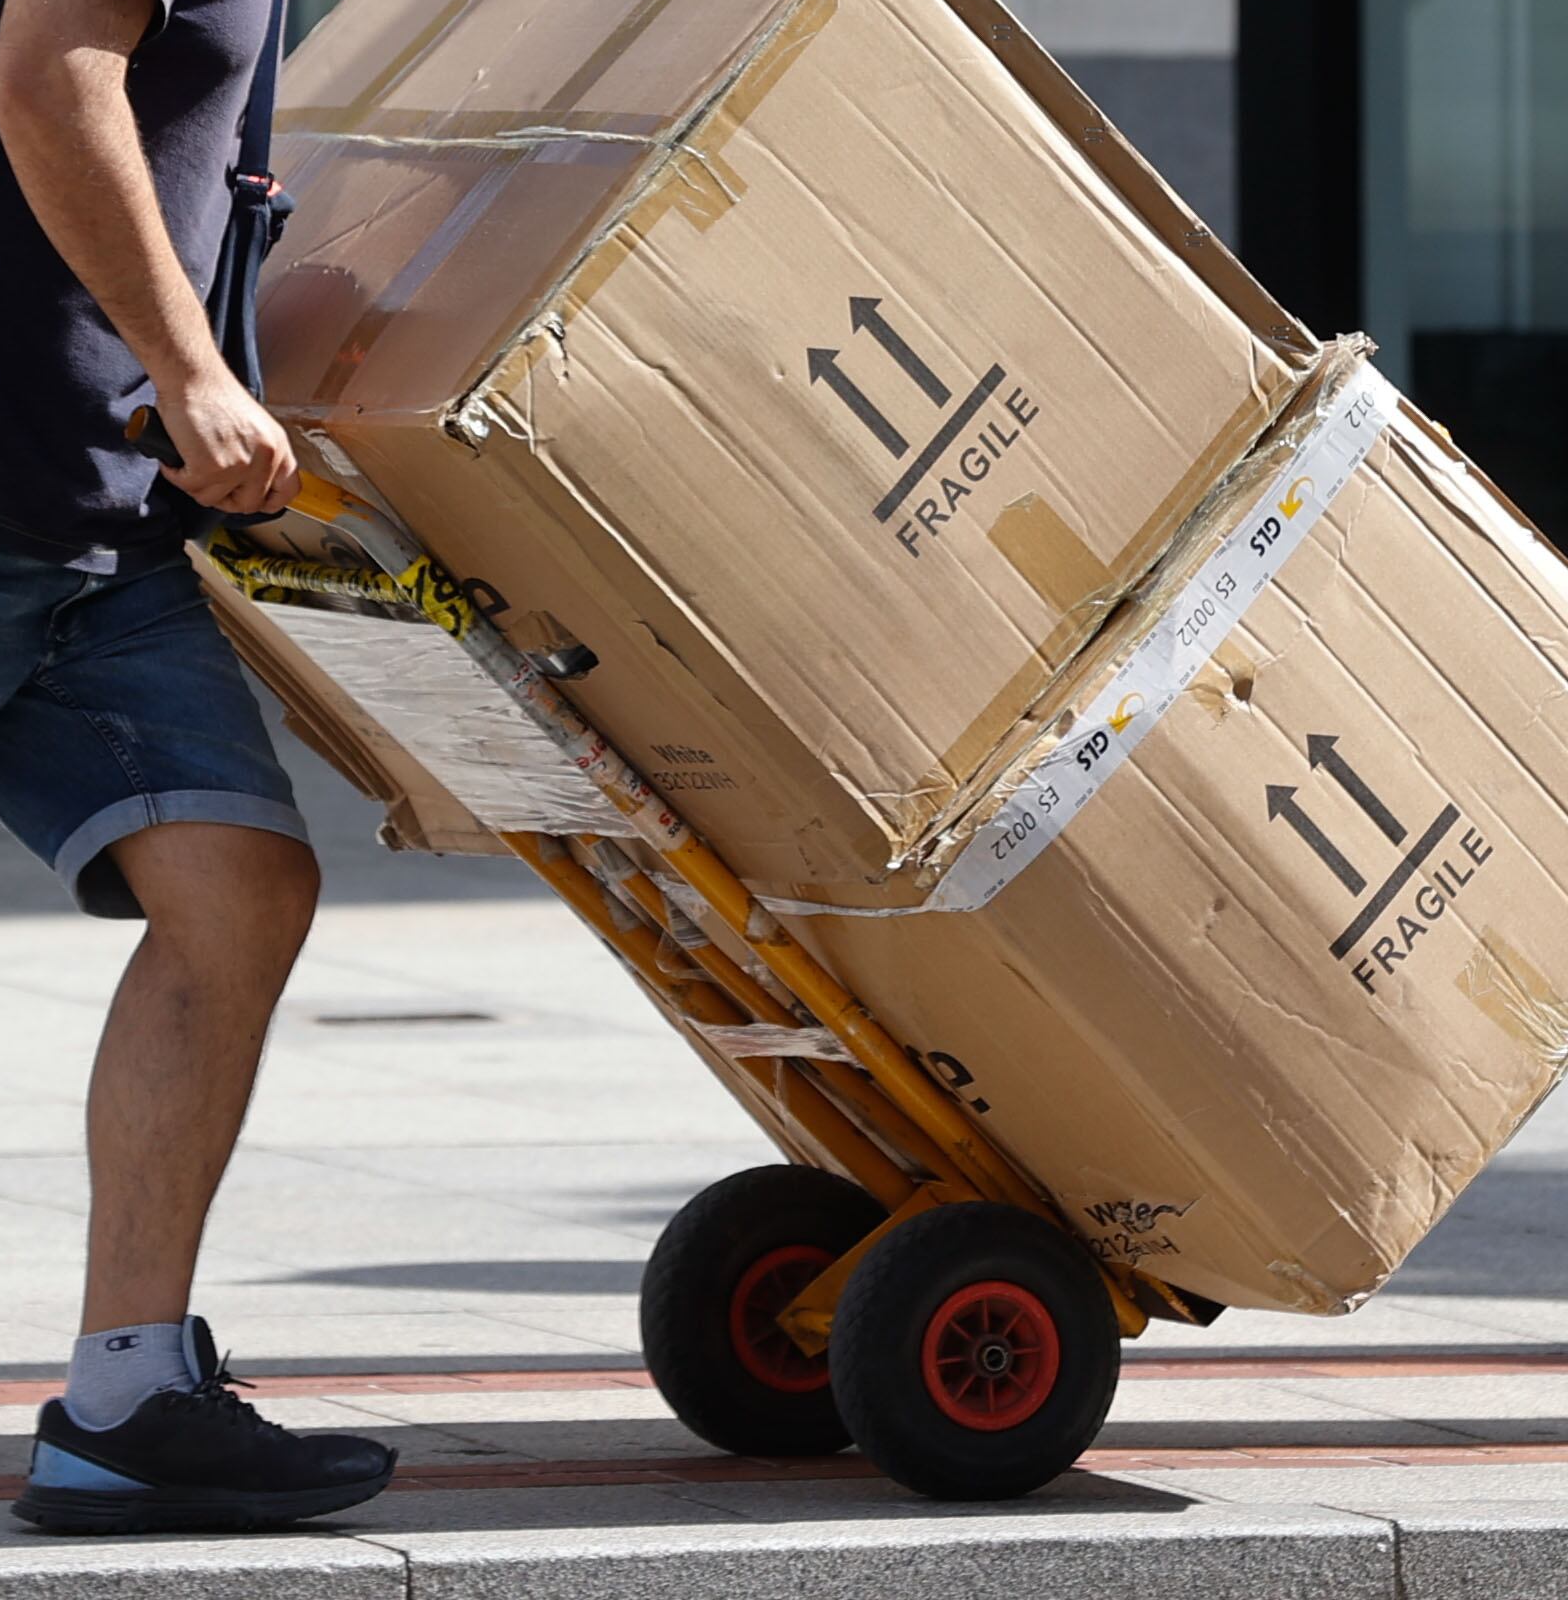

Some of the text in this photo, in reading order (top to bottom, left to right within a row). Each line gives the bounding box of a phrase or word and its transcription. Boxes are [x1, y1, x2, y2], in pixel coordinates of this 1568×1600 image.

[895, 387, 1040, 560] FRAGILE
[1250, 516, 1281, 557] GLS
[1215, 572, 1237, 600] ES
[1176, 598, 1216, 647] 0012
[650, 744, 715, 765] White
[1076, 730, 1109, 772] GLS
[1038, 786, 1060, 814] ES
[990, 812, 1036, 860] 0012
[1350, 827, 1494, 996] FRAGILE
